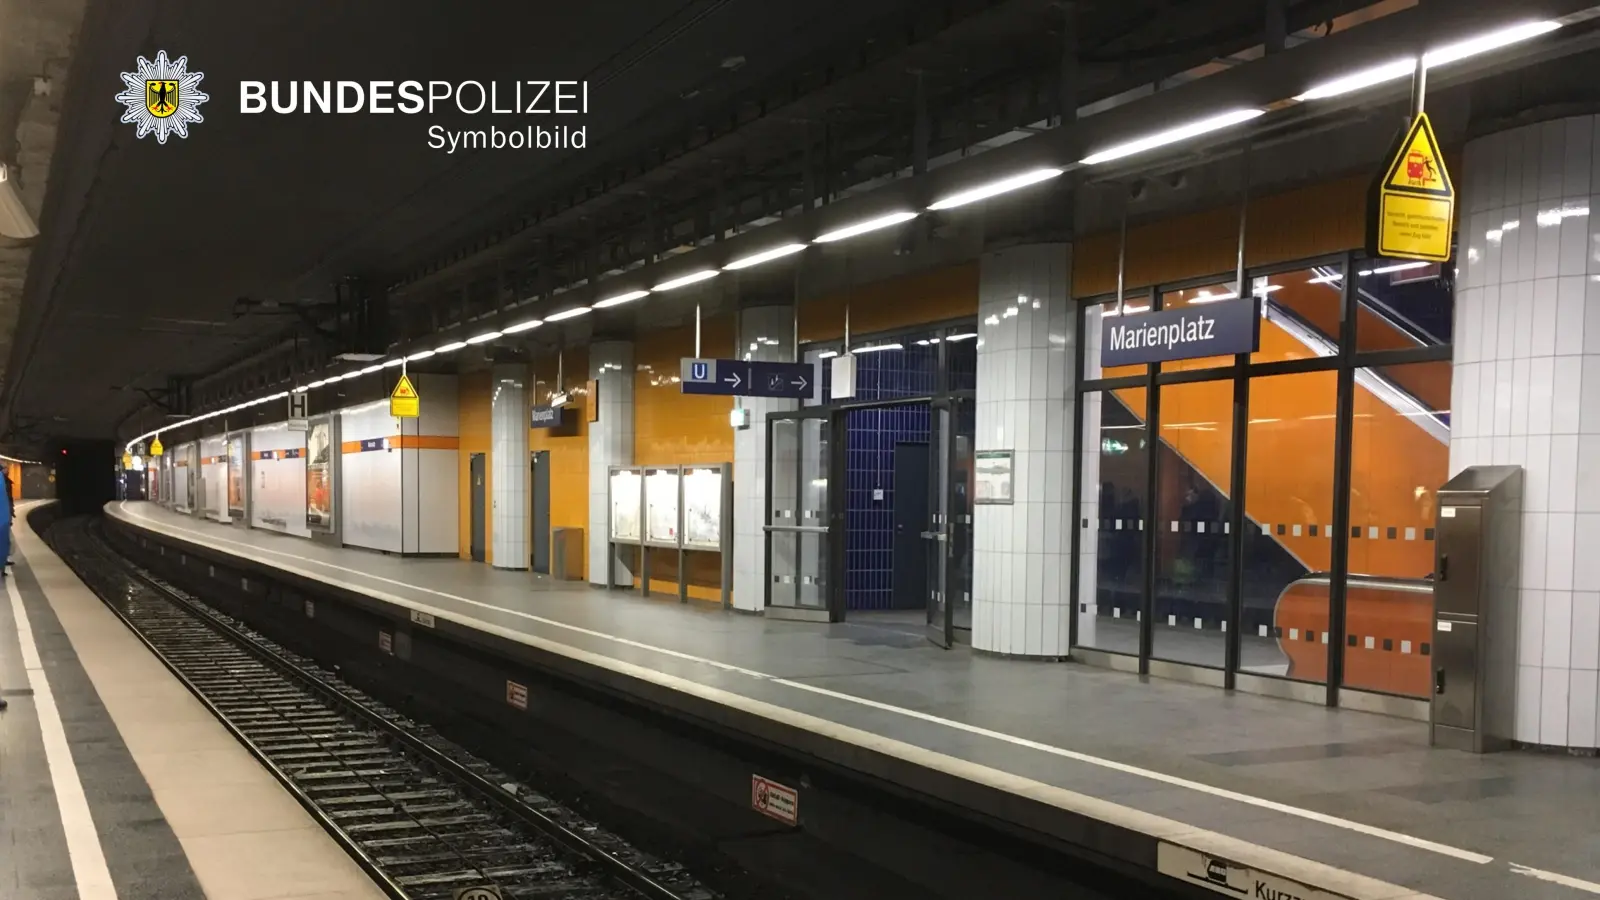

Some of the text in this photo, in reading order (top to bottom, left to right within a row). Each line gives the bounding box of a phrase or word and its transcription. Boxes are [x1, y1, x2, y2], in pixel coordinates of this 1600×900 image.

[1110, 315, 1215, 351] Marienplatz
[694, 363, 705, 379] U
[290, 395, 305, 417] H
